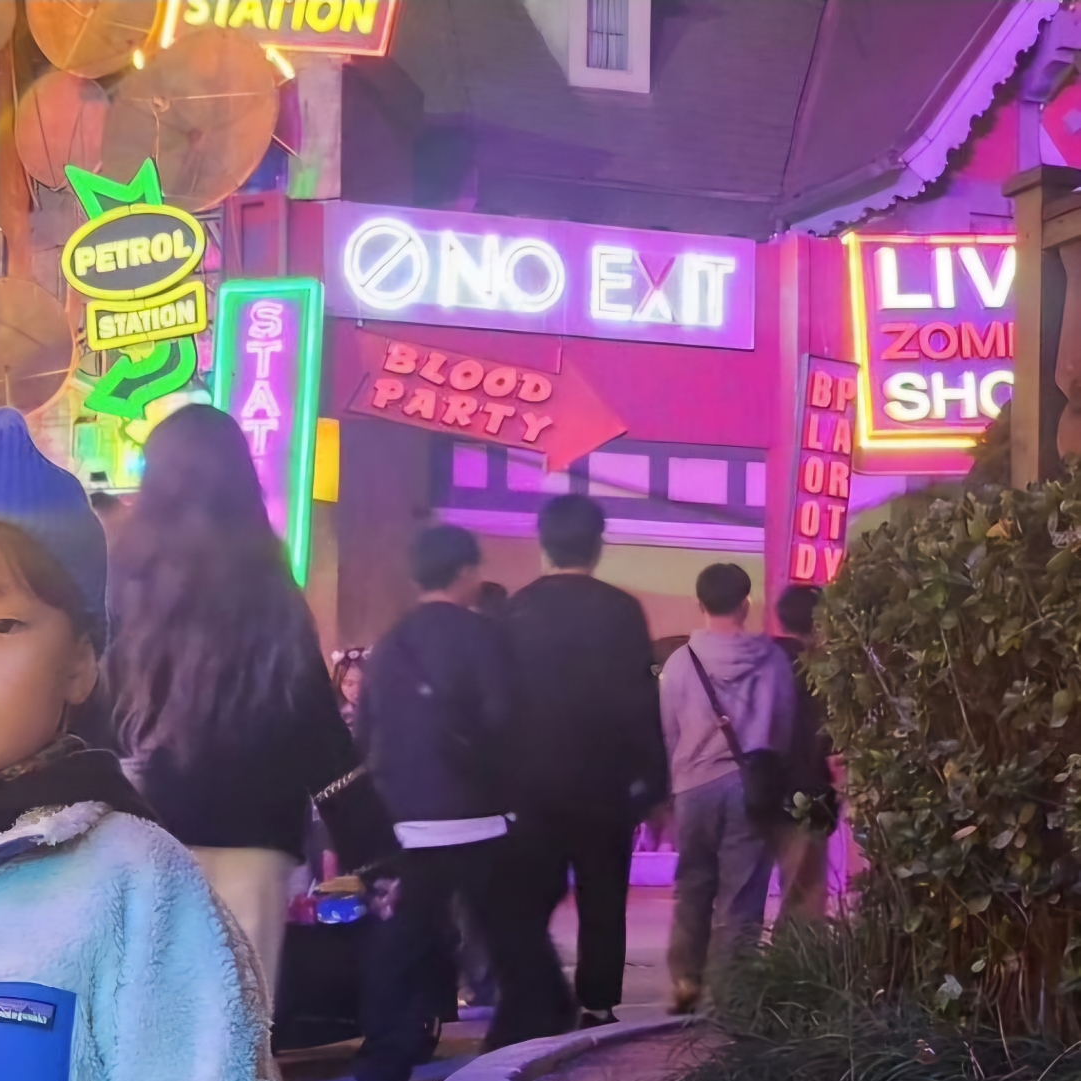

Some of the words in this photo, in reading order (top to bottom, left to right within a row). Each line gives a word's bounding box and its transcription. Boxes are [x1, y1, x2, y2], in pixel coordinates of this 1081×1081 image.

[184, 0, 378, 34] STATION
[74, 228, 192, 276] PETROL
[439, 229, 566, 313] NO
[591, 244, 736, 326] EXIT
[875, 246, 1016, 310] LIV
[98, 299, 195, 339] STATION
[880, 321, 1014, 361] ZOM
[240, 300, 283, 484] STAT
[383, 341, 553, 403] BLOOD
[372, 377, 554, 444] PARTY
[790, 369, 834, 582] BLOOD
